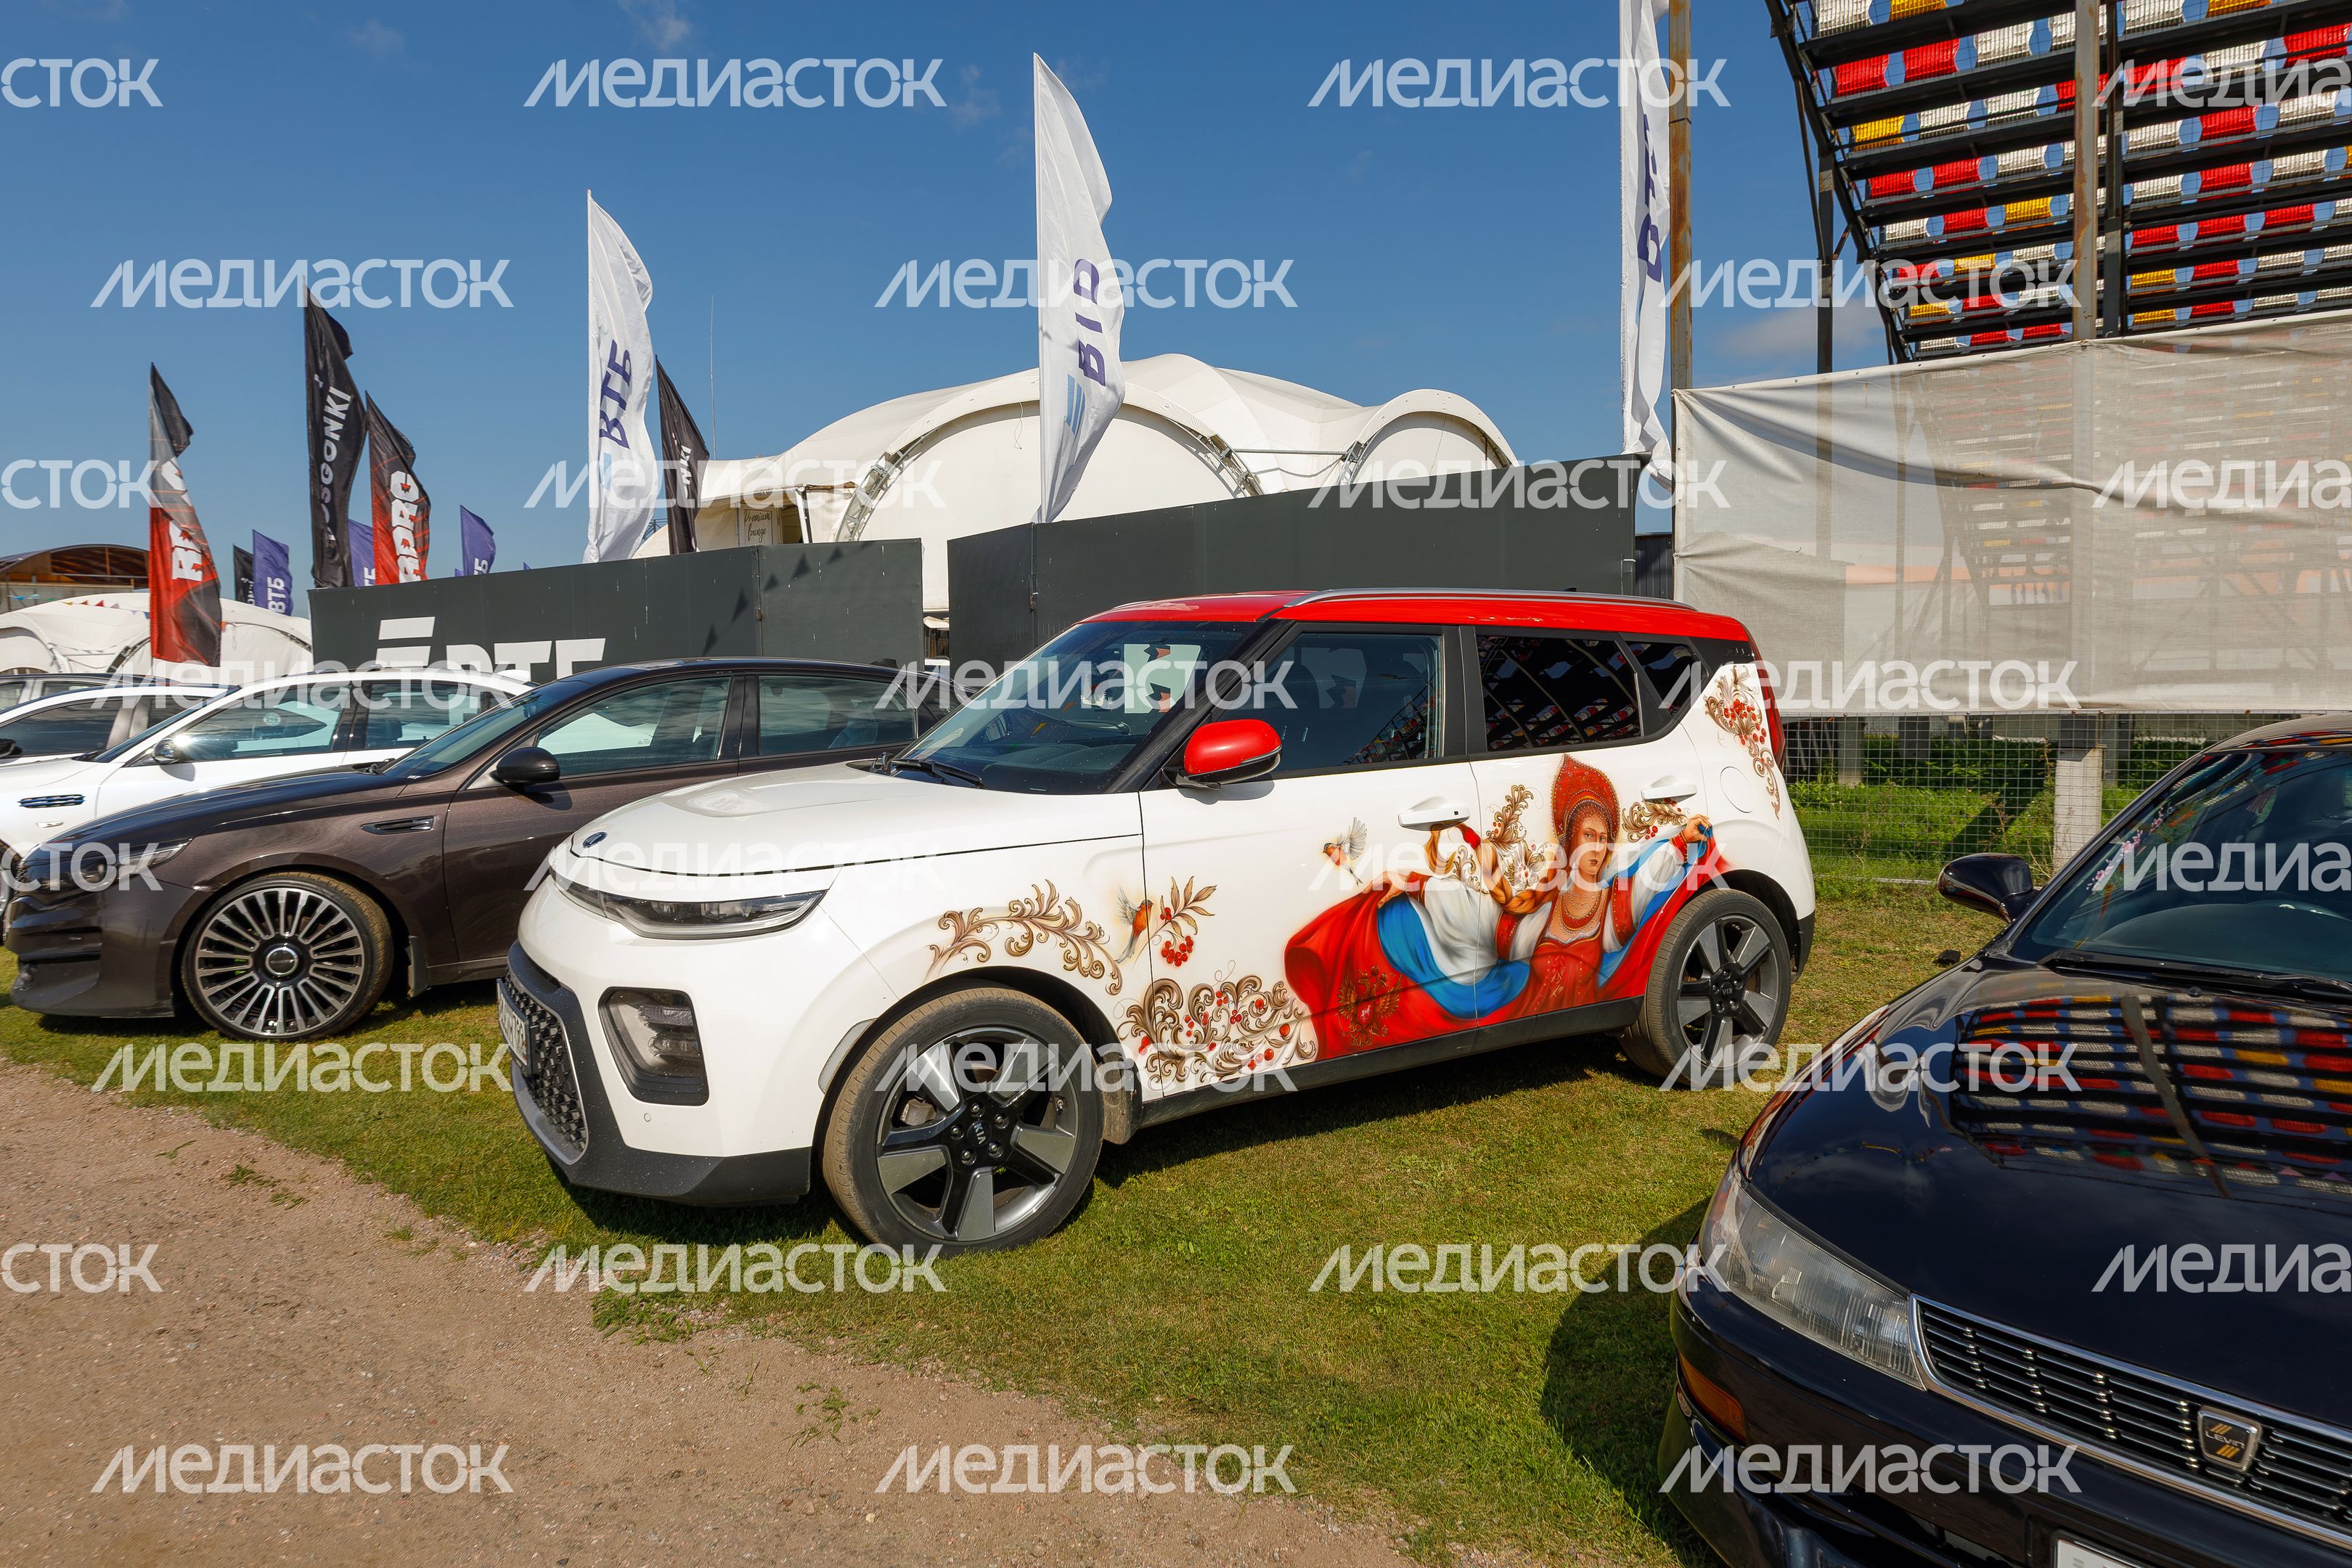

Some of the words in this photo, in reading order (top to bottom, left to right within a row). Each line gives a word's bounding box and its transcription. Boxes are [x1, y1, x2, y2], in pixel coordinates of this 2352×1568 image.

[599, 339, 632, 449] ВТБ
[266, 576, 286, 613] ВТБ
[973, 1122, 986, 1145] KIA
